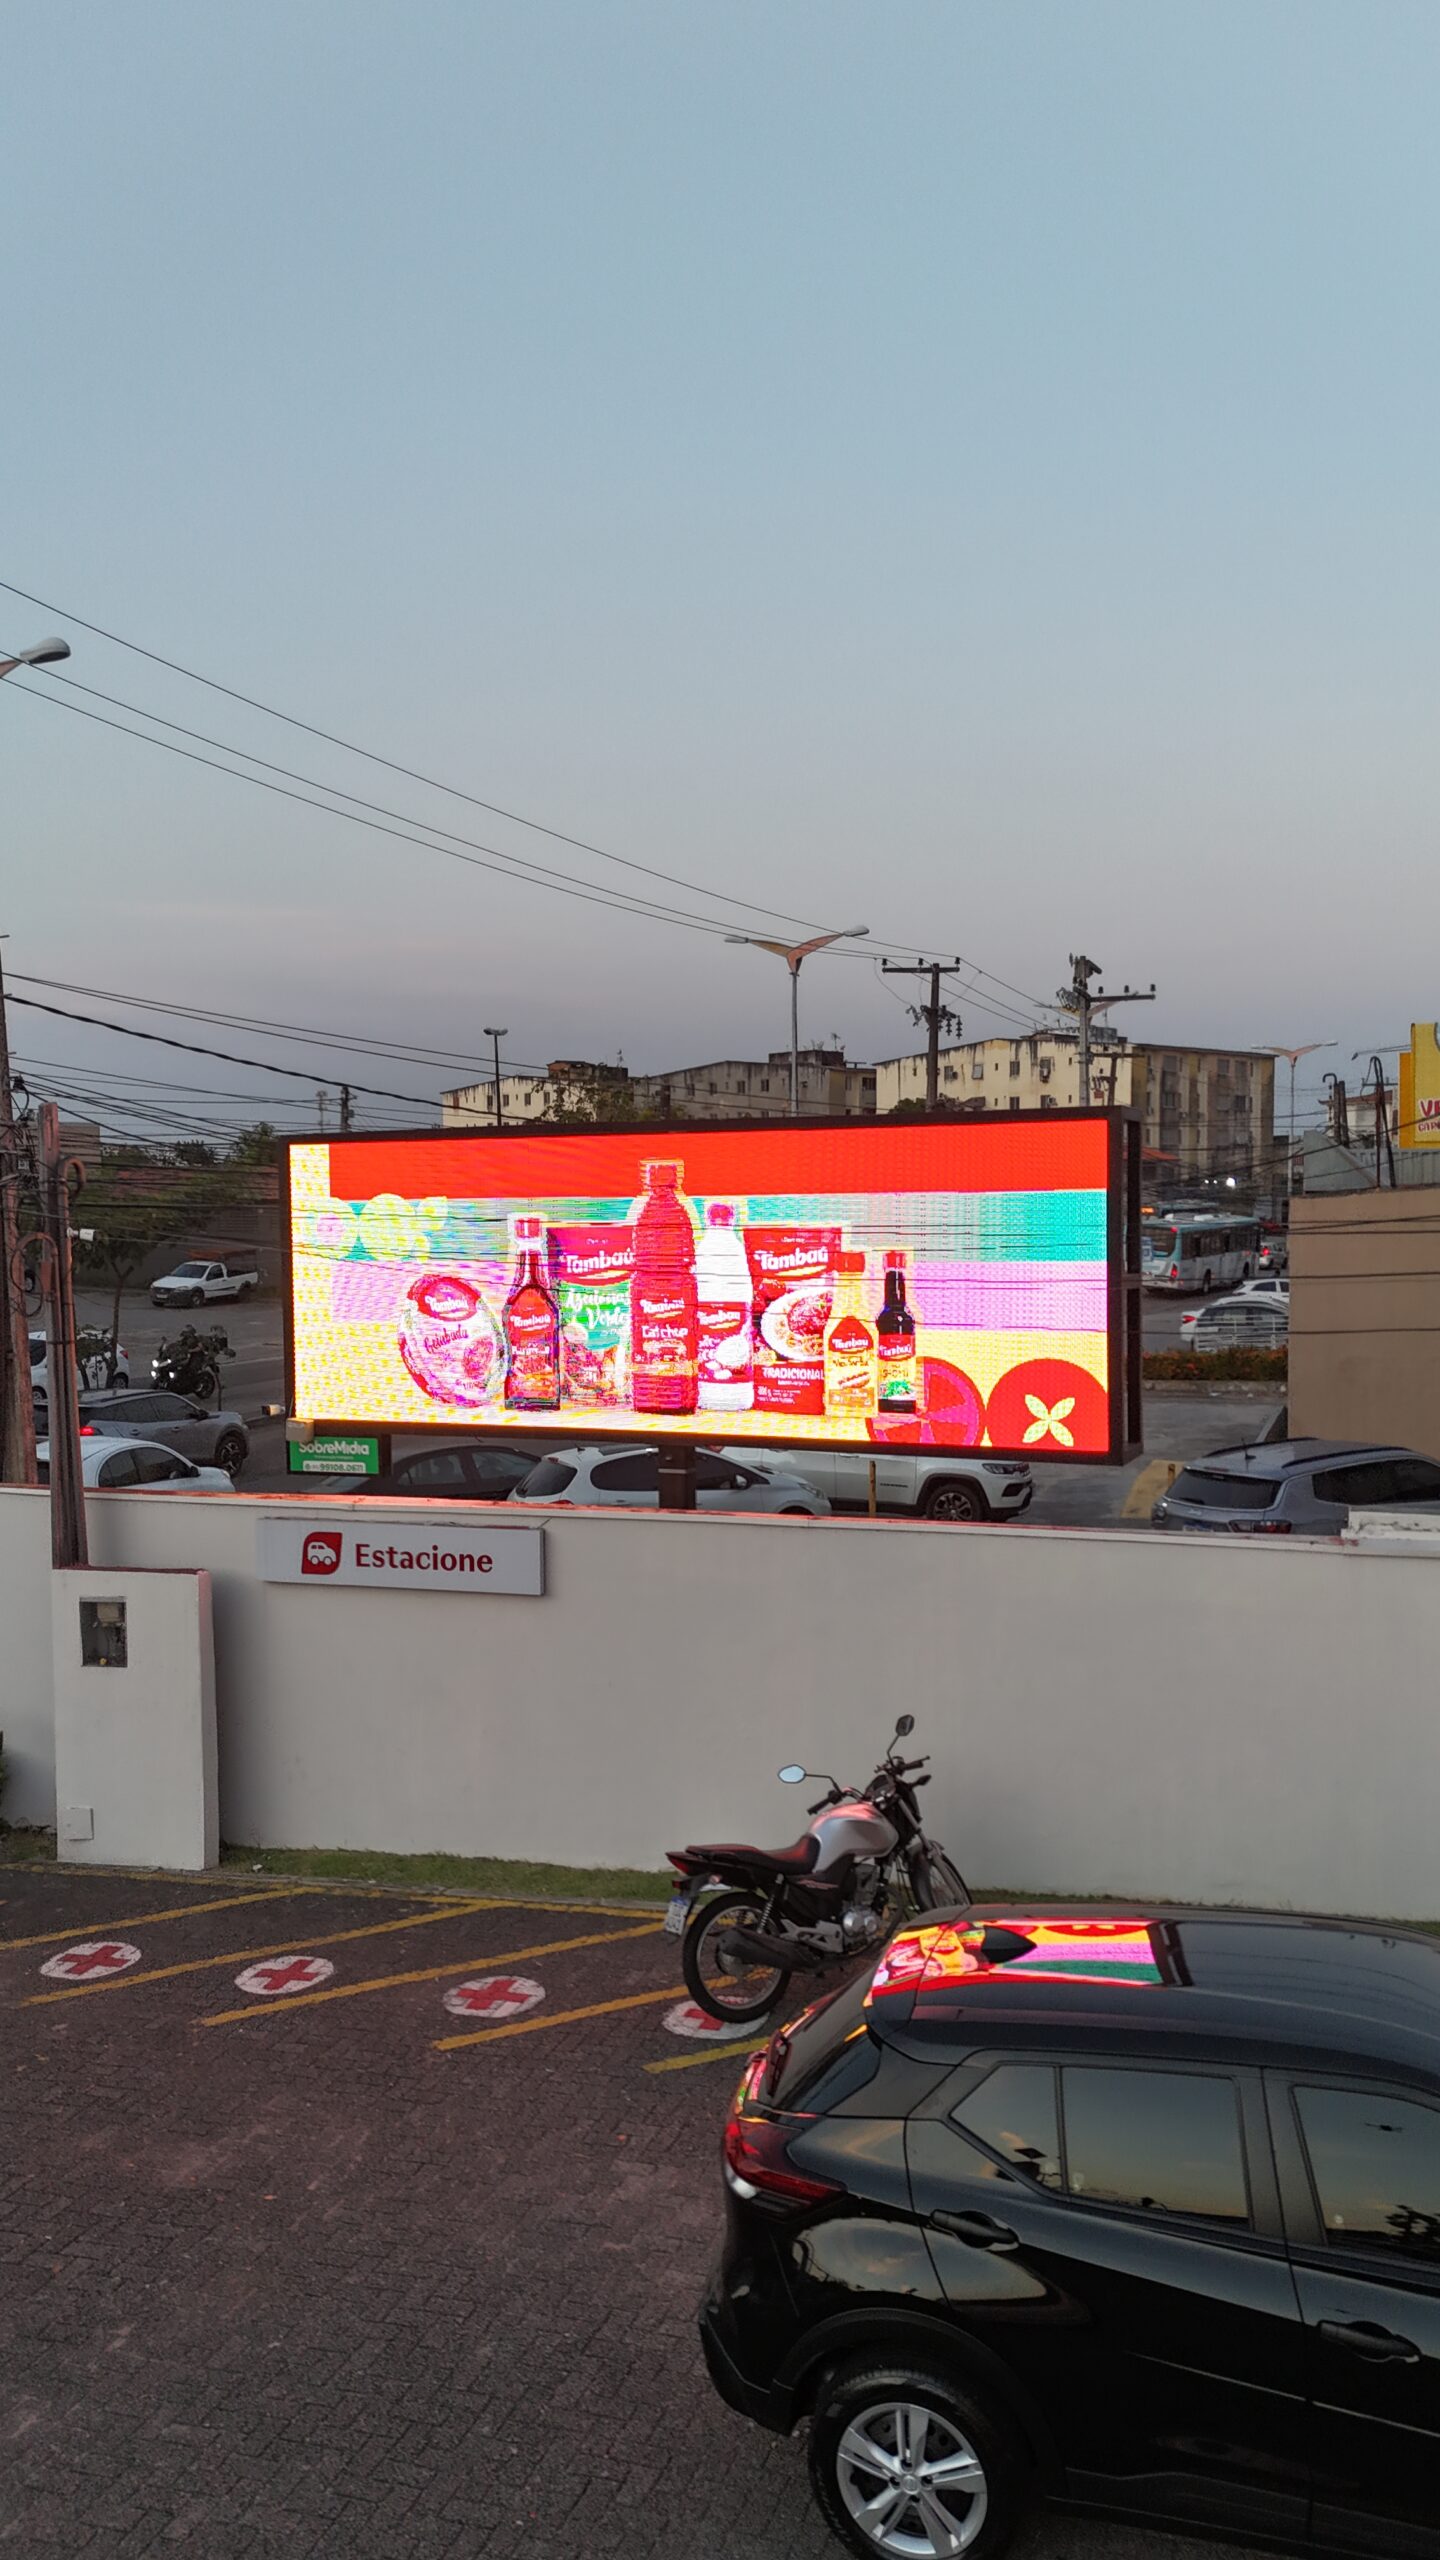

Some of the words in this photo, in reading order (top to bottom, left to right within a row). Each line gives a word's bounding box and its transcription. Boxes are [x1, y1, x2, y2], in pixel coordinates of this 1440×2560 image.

[753, 1246, 828, 1270] Tambaú
[762, 1367, 825, 1380] TRADICIONAL
[355, 1543, 493, 1573] Estacione
